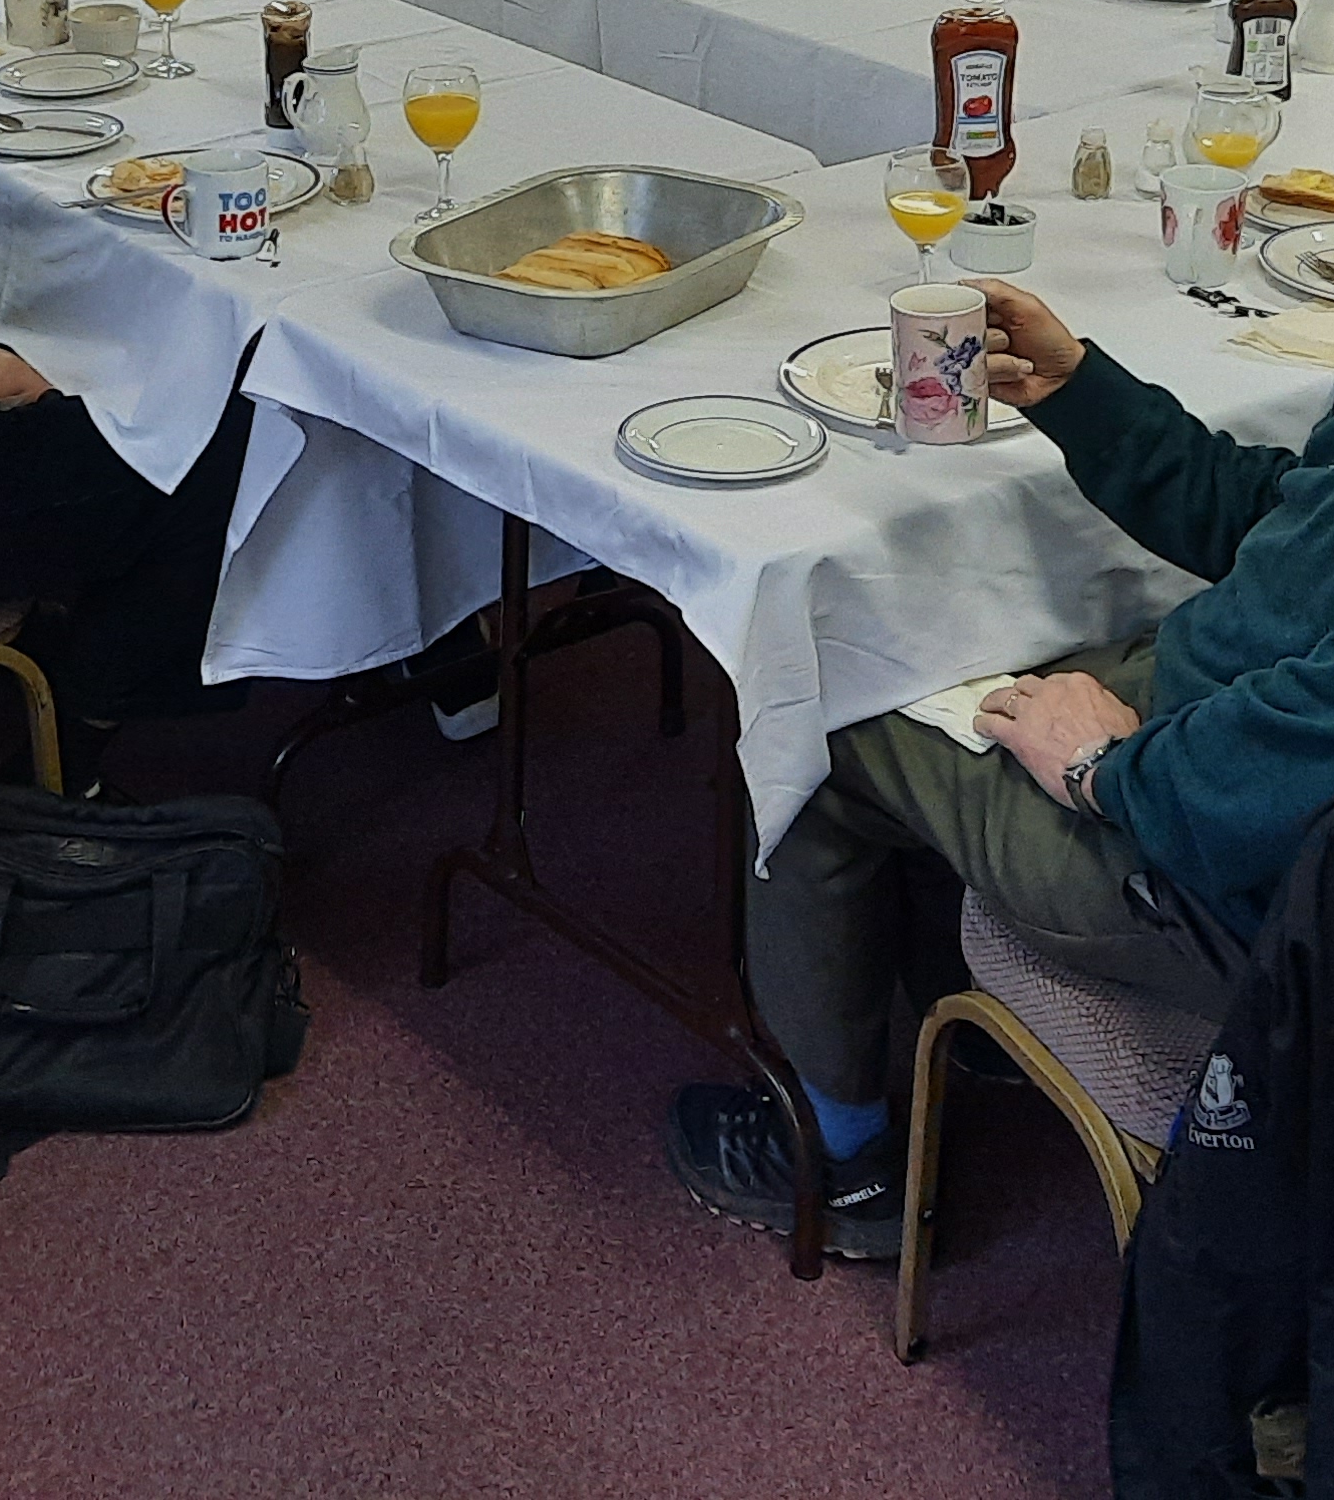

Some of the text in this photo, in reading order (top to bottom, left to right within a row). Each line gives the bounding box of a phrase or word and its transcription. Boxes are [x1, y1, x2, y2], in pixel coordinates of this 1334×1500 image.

[960, 72, 998, 82] TOMATO
[218, 187, 267, 212] TOO
[218, 206, 267, 234] HOT
[1188, 1122, 1255, 1150] Everton
